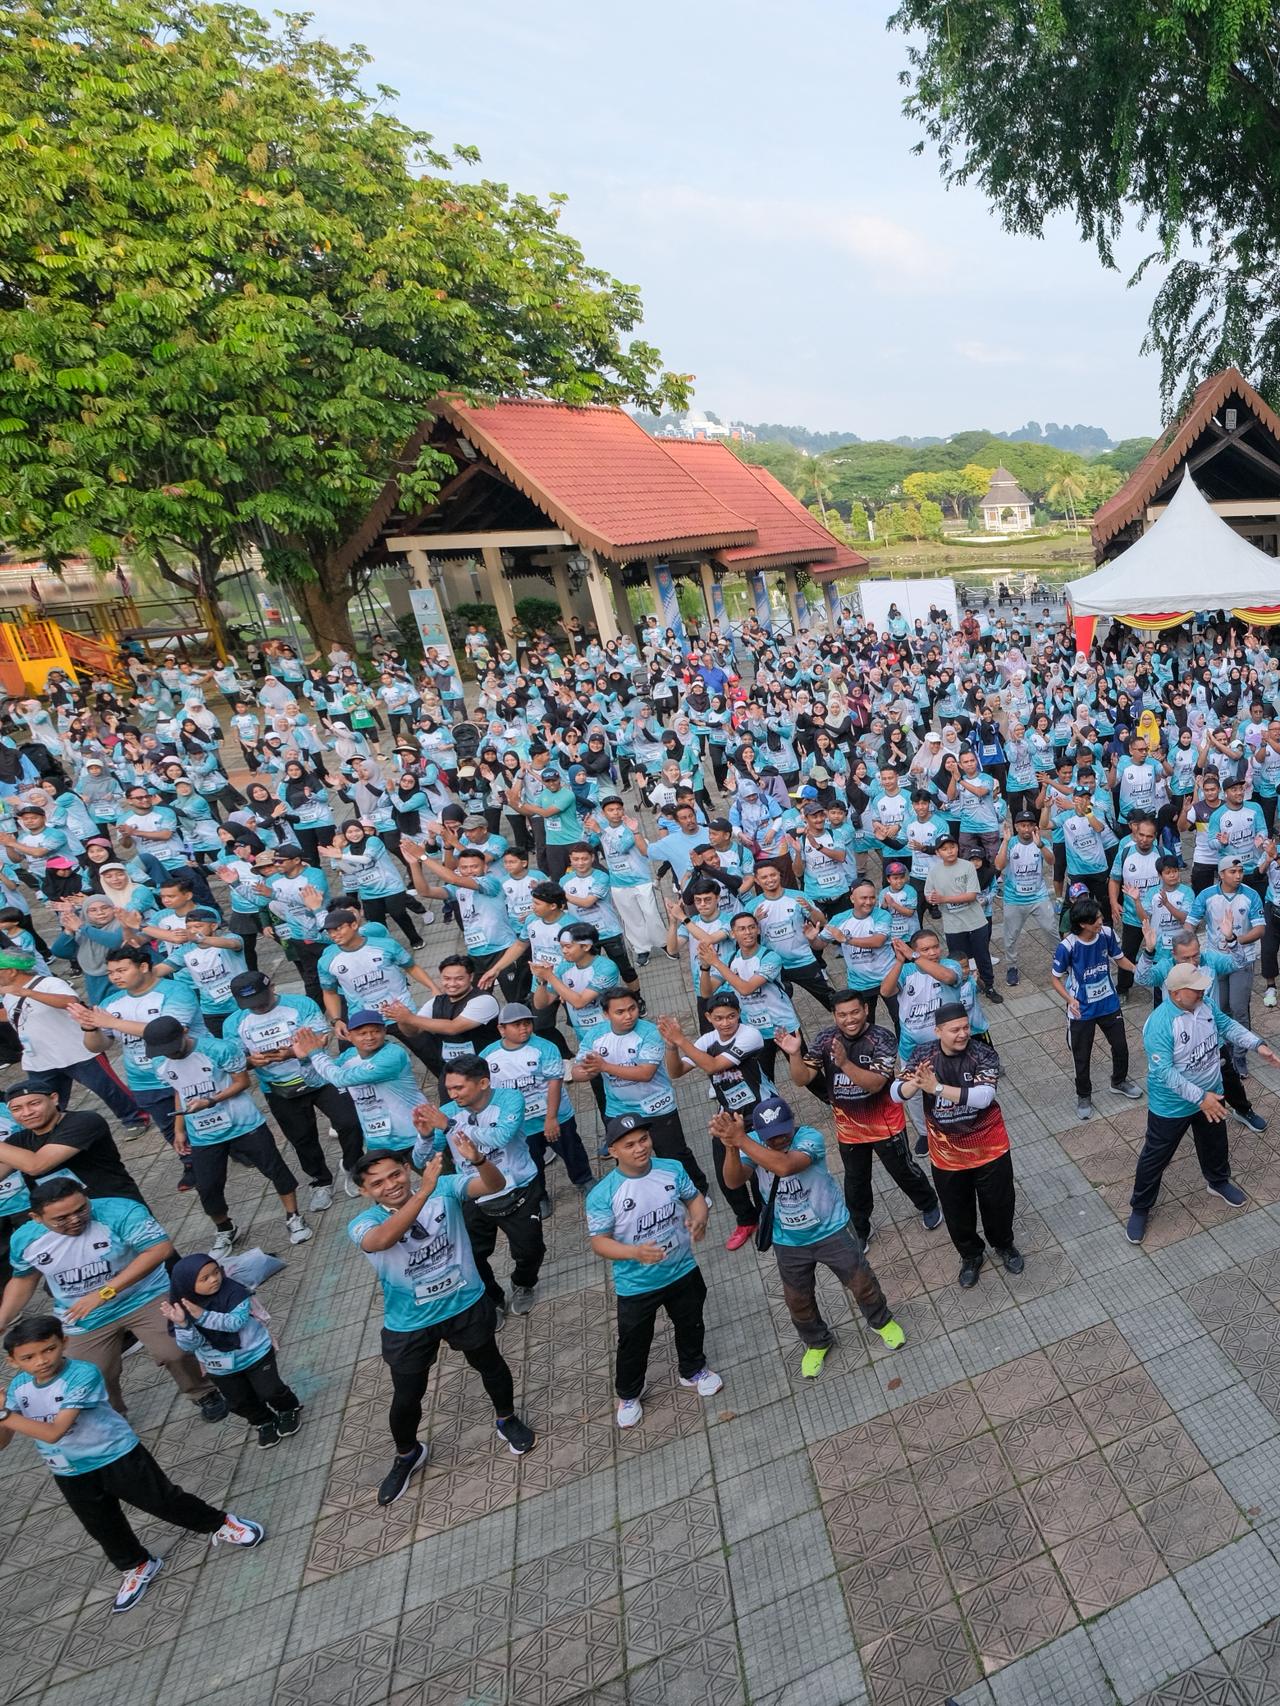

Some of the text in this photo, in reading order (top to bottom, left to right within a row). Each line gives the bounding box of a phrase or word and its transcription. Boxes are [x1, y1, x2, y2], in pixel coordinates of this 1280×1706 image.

[259, 1027, 281, 1038] 1422
[650, 1096, 671, 1112] 2050
[198, 1115, 223, 1127] 2594
[637, 1211, 656, 1233] FUN
[656, 1202, 676, 1223] RUN
[54, 1260, 111, 1285] FUN RUN
[426, 1279, 452, 1293] 1873
